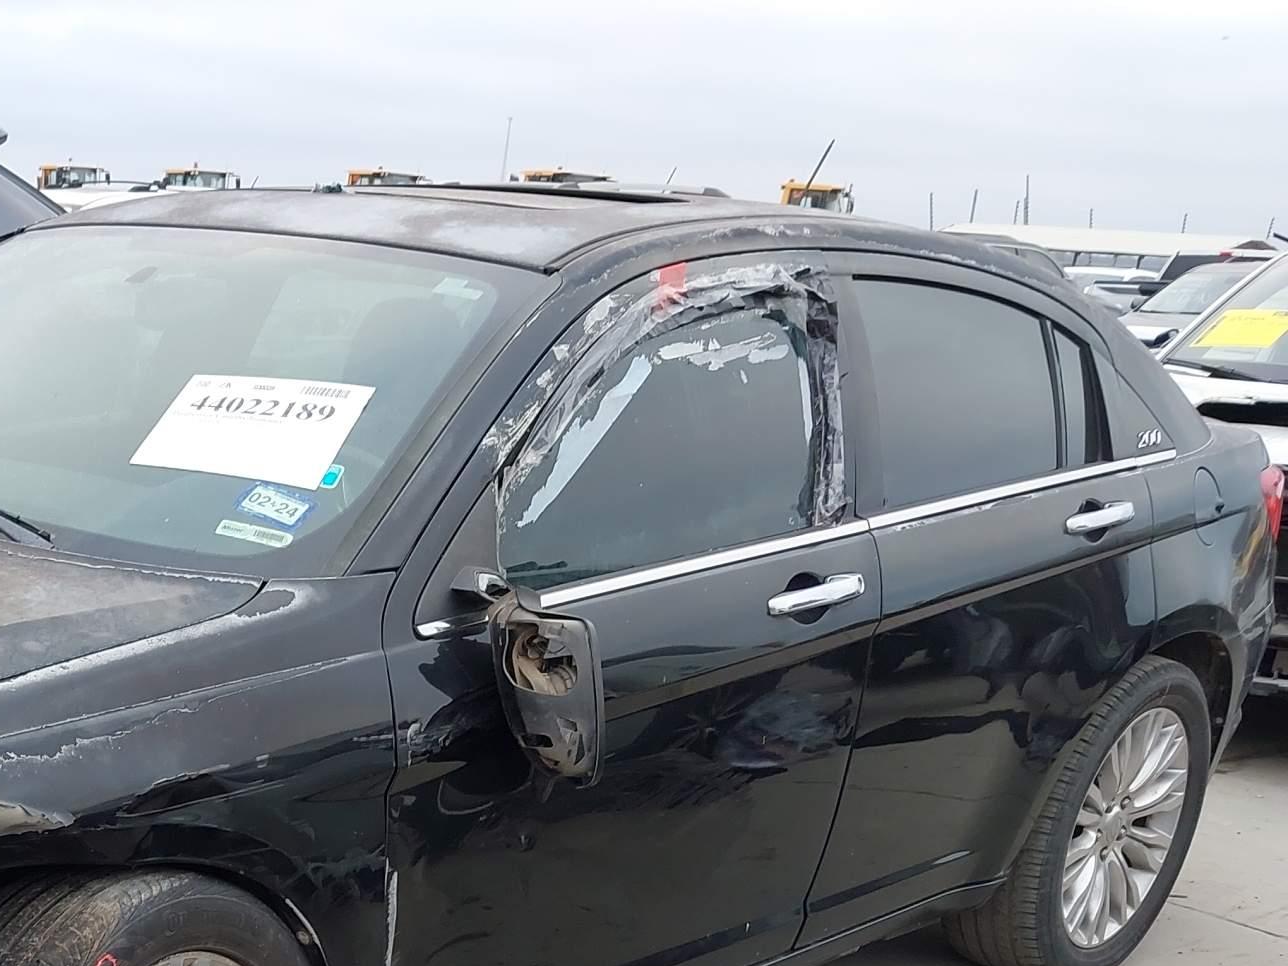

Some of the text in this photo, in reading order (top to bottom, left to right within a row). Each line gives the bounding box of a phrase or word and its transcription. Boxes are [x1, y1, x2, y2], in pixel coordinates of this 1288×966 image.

[190, 394, 337, 422] 44022189
[248, 492, 299, 519] 02 24
